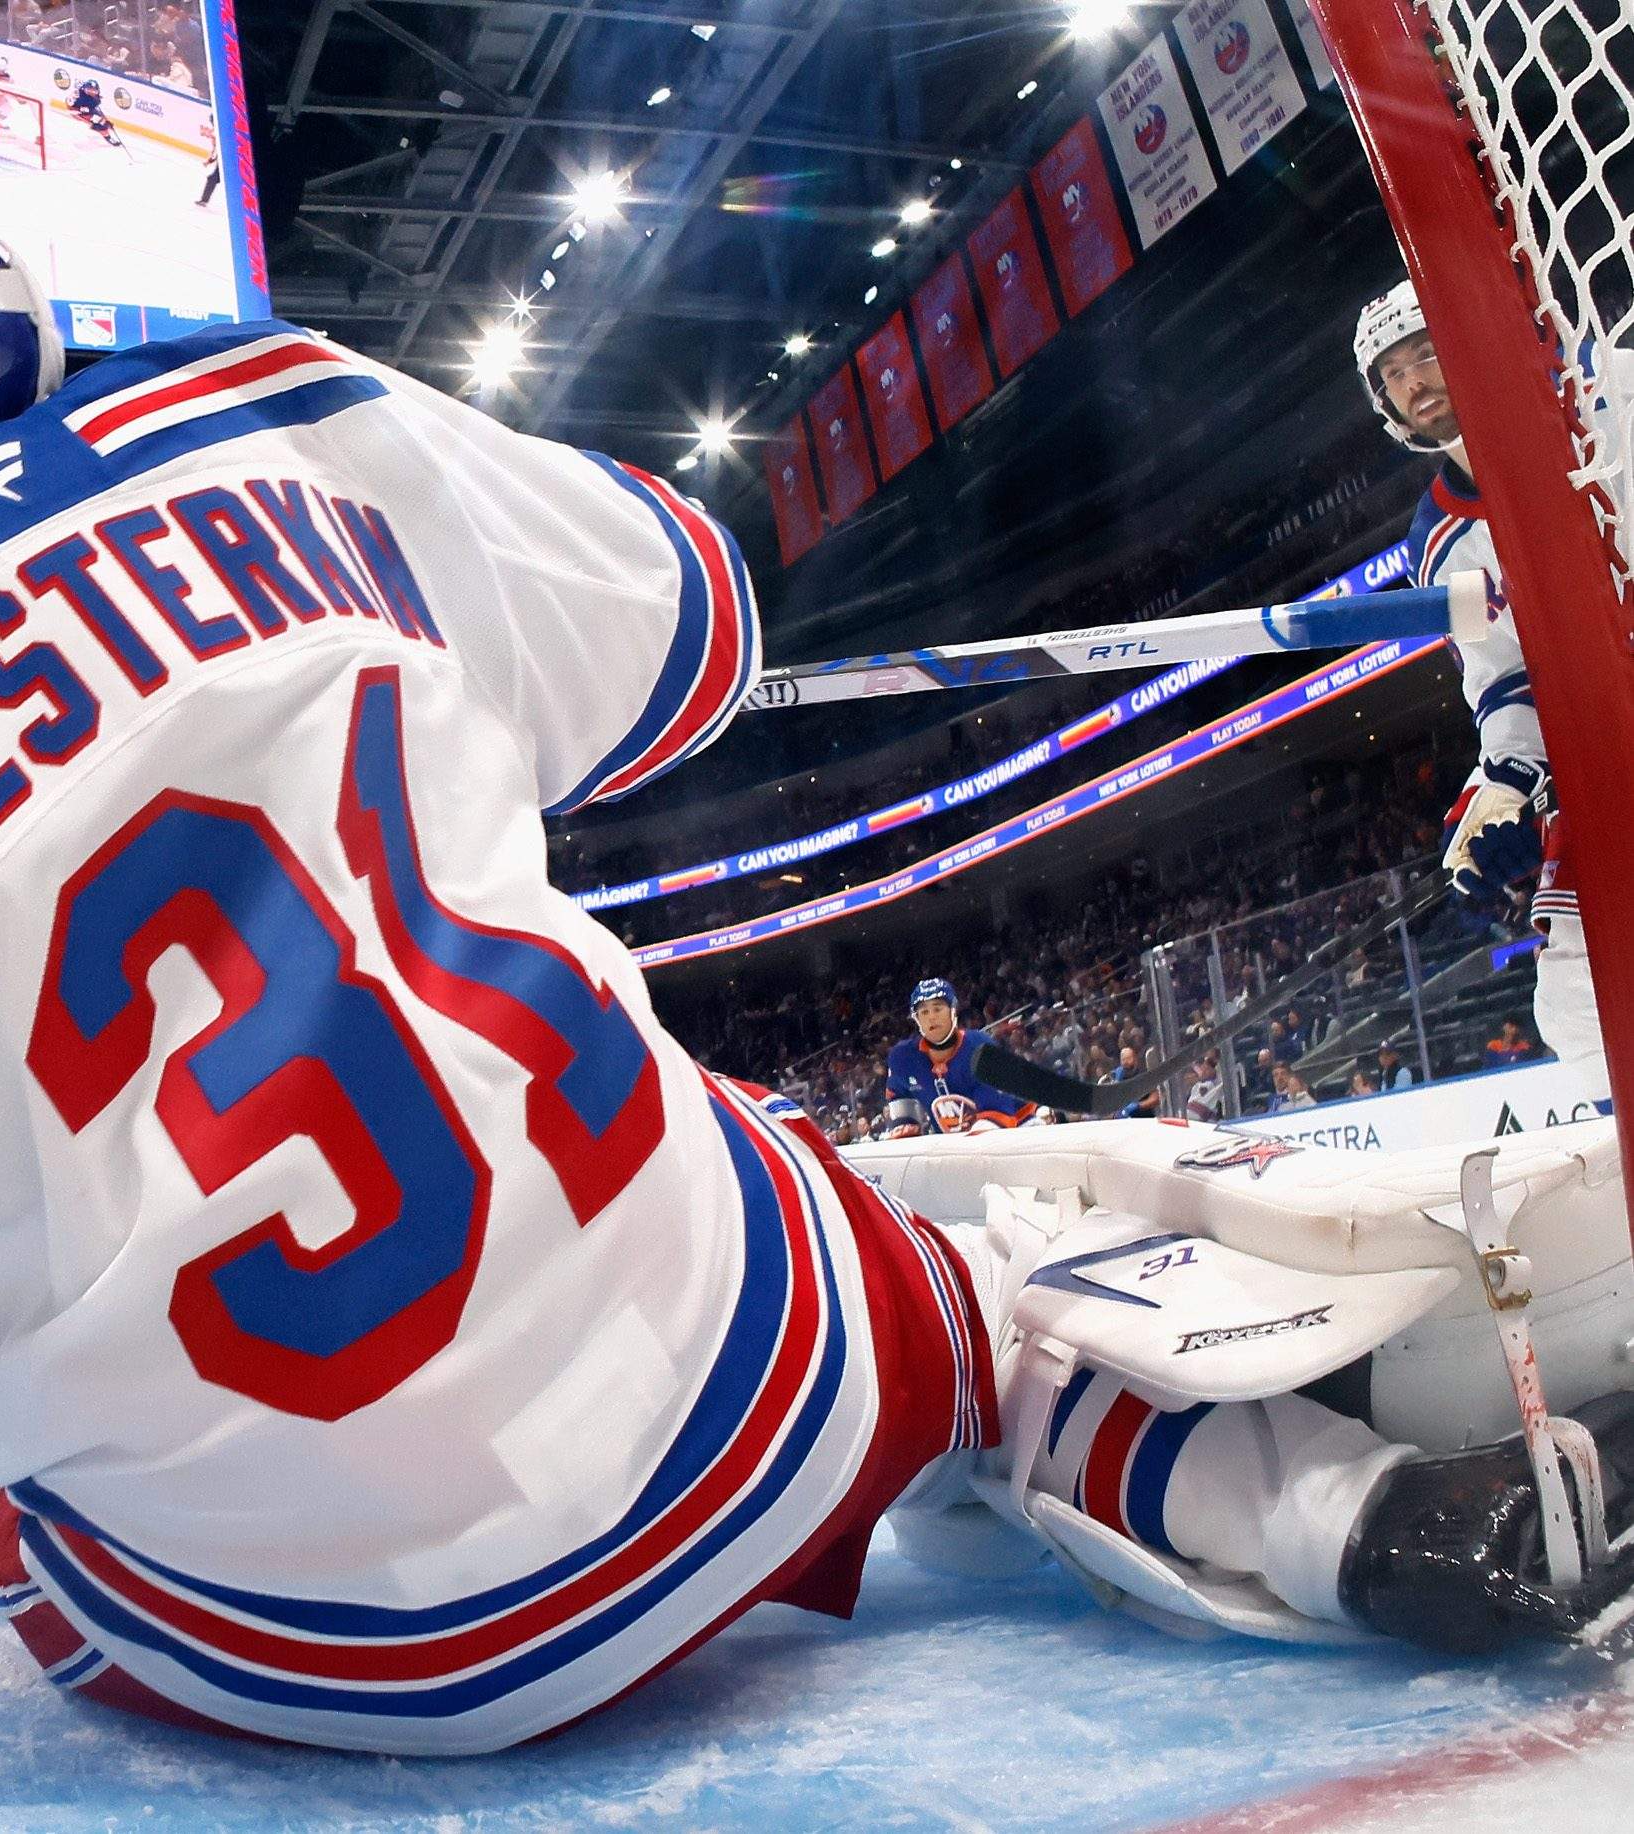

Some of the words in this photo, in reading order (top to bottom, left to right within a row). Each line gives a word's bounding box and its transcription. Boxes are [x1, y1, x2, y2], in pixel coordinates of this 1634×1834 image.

[224, 33, 256, 189] RICHARD
[245, 216, 270, 295] SON
[1369, 309, 1402, 336] CCM
[1086, 641, 1159, 661] RTL
[1305, 679, 1329, 700] NEW
[1330, 664, 1359, 688] YORK
[1358, 642, 1402, 674] LOTTERY
[1131, 685, 1161, 713] CAN
[1211, 724, 1234, 744] PLAY
[1233, 711, 1263, 734] TODAY
[944, 781, 974, 805] CAN
[973, 769, 999, 794] YOU
[997, 741, 1051, 782] IMAGINE?
[1099, 781, 1118, 798] NEW
[1117, 769, 1141, 790] YORK
[1139, 753, 1173, 779] LOTTERY
[738, 850, 768, 872] CAN
[768, 839, 800, 865] YOU
[799, 823, 859, 855] IMAGINE?
[709, 934, 729, 948] PLAY
[728, 929, 752, 944] TODAY
[25, 665, 666, 1422] 31
[1139, 1246, 1199, 1281] 31
